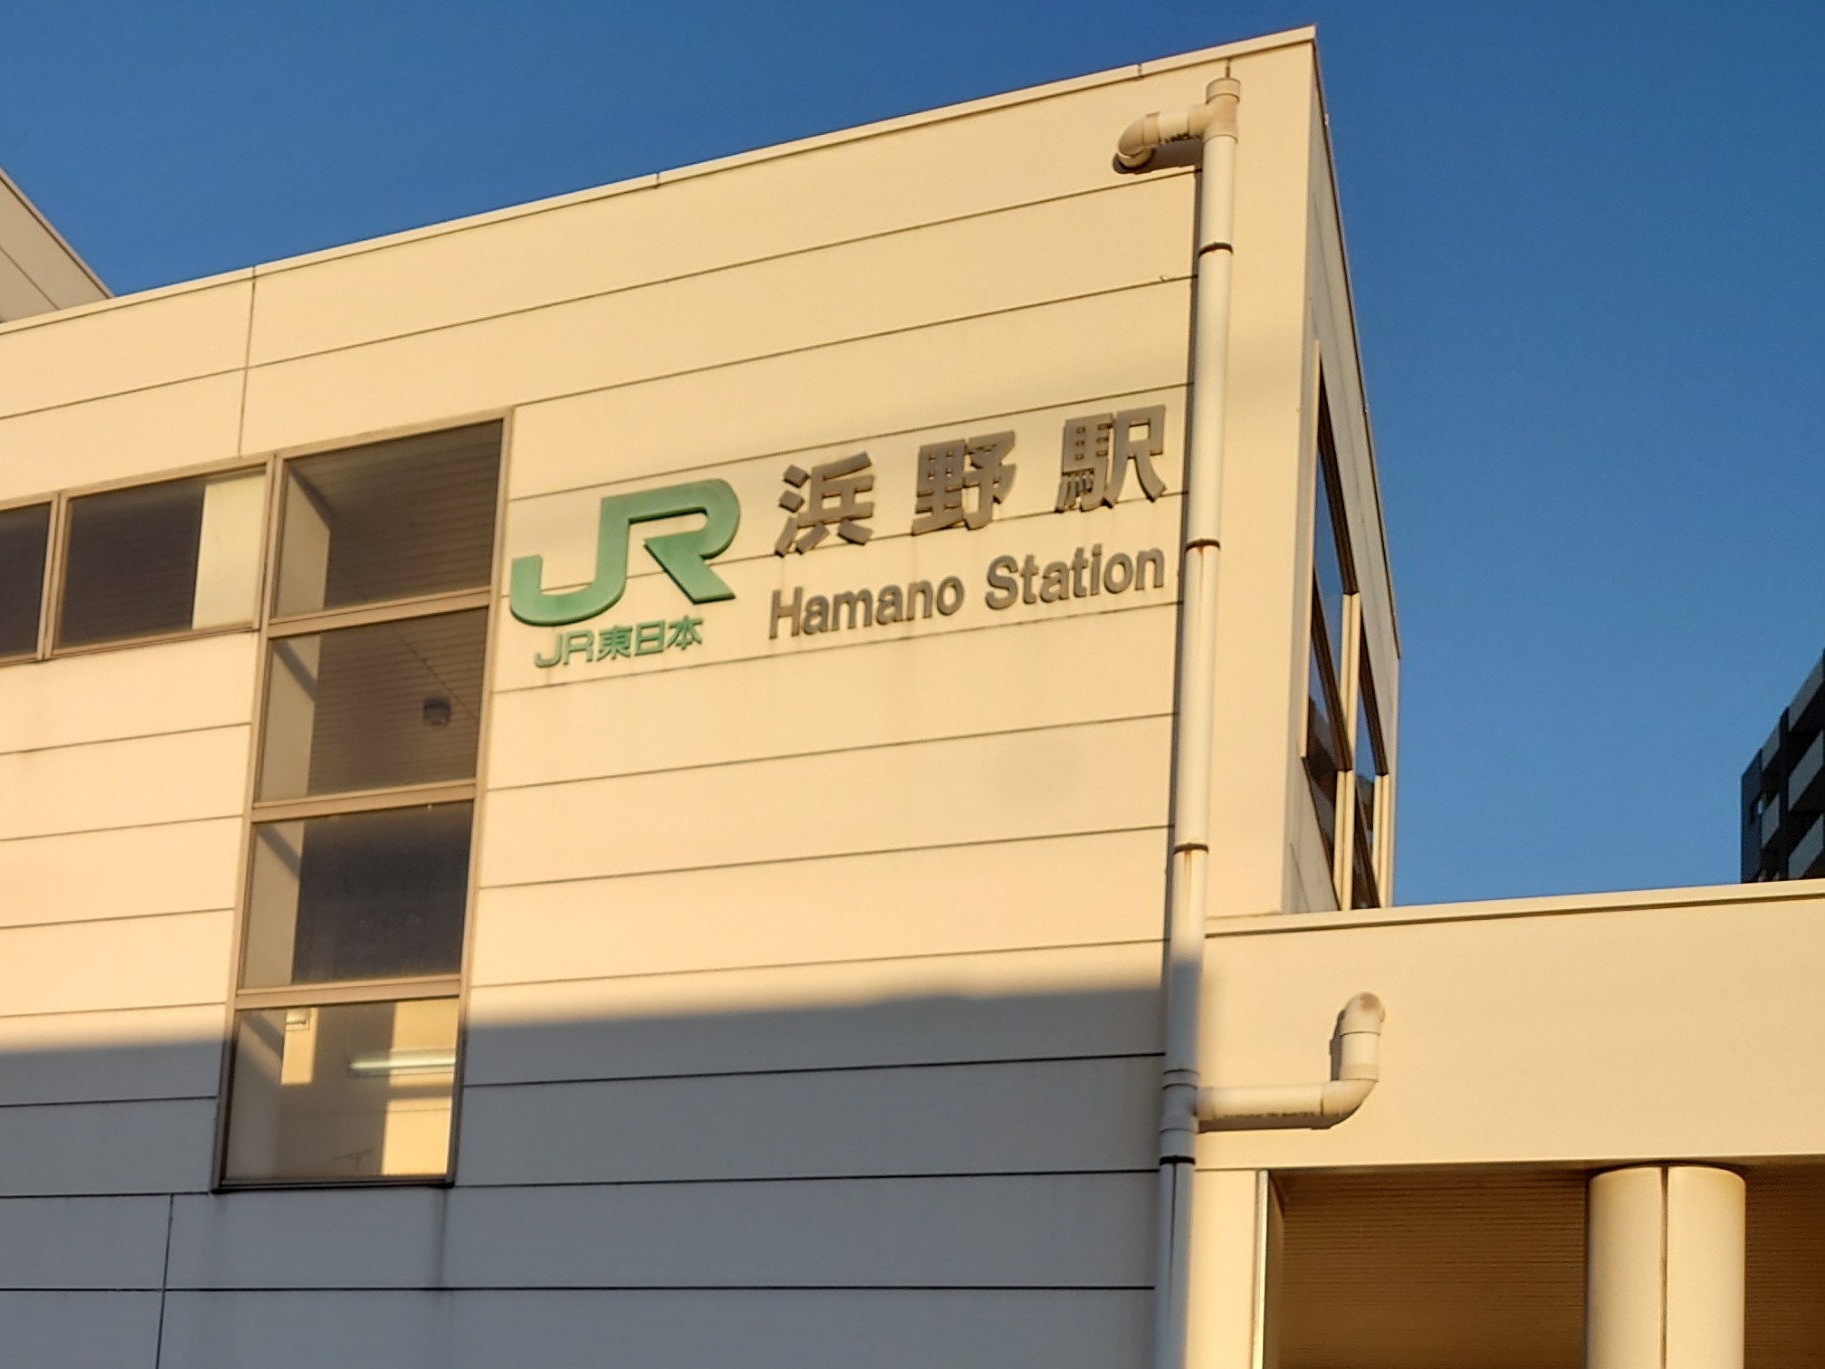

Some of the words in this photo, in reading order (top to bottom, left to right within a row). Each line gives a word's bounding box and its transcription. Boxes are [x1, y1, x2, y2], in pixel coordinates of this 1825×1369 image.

[775, 404, 1166, 557] 浜野駅
[510, 478, 740, 627] JR
[769, 576, 964, 639] Hamano
[985, 543, 1165, 610] Station
[535, 615, 703, 668] JR東日本
